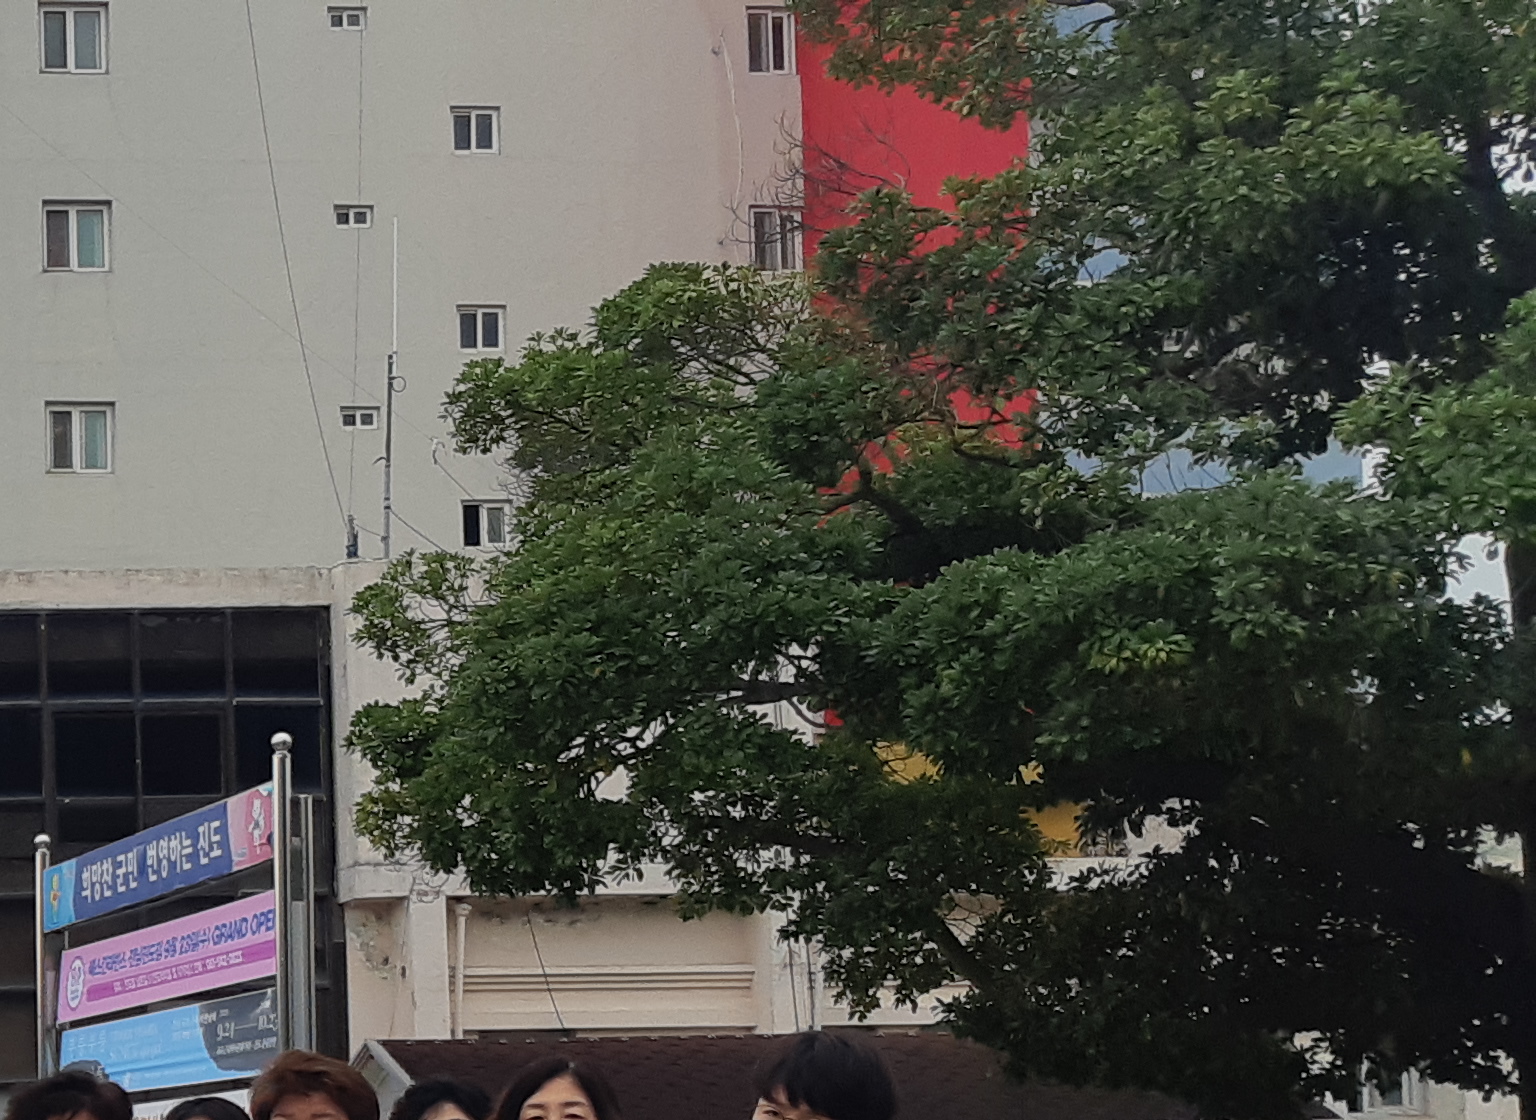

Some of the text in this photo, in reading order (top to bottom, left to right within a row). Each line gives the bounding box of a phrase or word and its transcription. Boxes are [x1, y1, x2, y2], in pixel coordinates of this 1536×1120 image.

[81, 820, 223, 903] 희망찬 군민 번영하는 진도
[212, 917, 249, 946] GRAND
[250, 908, 275, 936] OPE
